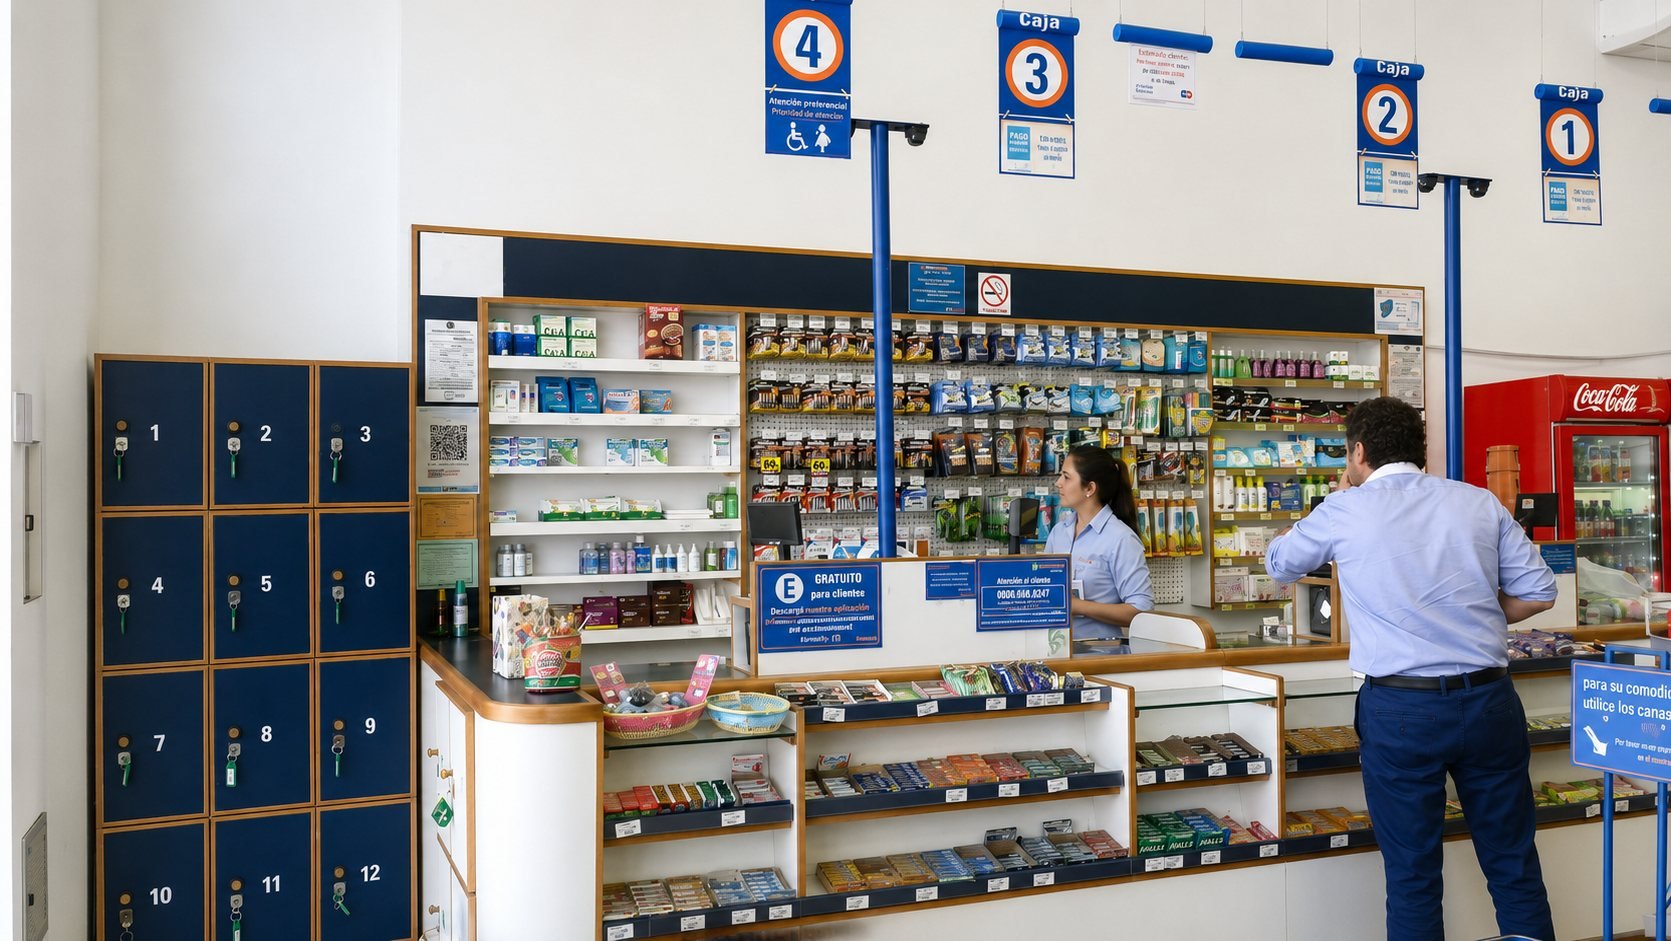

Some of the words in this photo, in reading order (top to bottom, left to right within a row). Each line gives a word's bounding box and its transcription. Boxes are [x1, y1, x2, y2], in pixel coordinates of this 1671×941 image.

[1019, 12, 1060, 31] Caja
[795, 25, 822, 68] 4
[1025, 53, 1049, 95] 3
[1377, 60, 1410, 78] Caja
[1559, 86, 1589, 102] Caja
[1378, 96, 1398, 134] 2
[1009, 132, 1028, 140] PAGO
[1560, 120, 1576, 155] 1
[1573, 382, 1640, 413] Coca-Cola
[150, 424, 160, 441] 1
[260, 425, 272, 442] 2
[360, 426, 371, 442] 3
[151, 577, 164, 594] 4
[261, 575, 272, 592] 5
[364, 571, 375, 588] 6
[814, 572, 862, 584] GRATUITO
[783, 577, 796, 599] E
[811, 590, 830, 601] para
[1583, 678, 1608, 691] para
[1609, 681, 1623, 693] su
[1583, 698, 1615, 712] utilice
[1618, 700, 1635, 715] los
[260, 726, 272, 742] 8
[365, 718, 376, 734] 9
[153, 734, 166, 751] 7
[360, 864, 381, 882] 12
[262, 875, 281, 893] 11
[150, 886, 173, 905] 10
